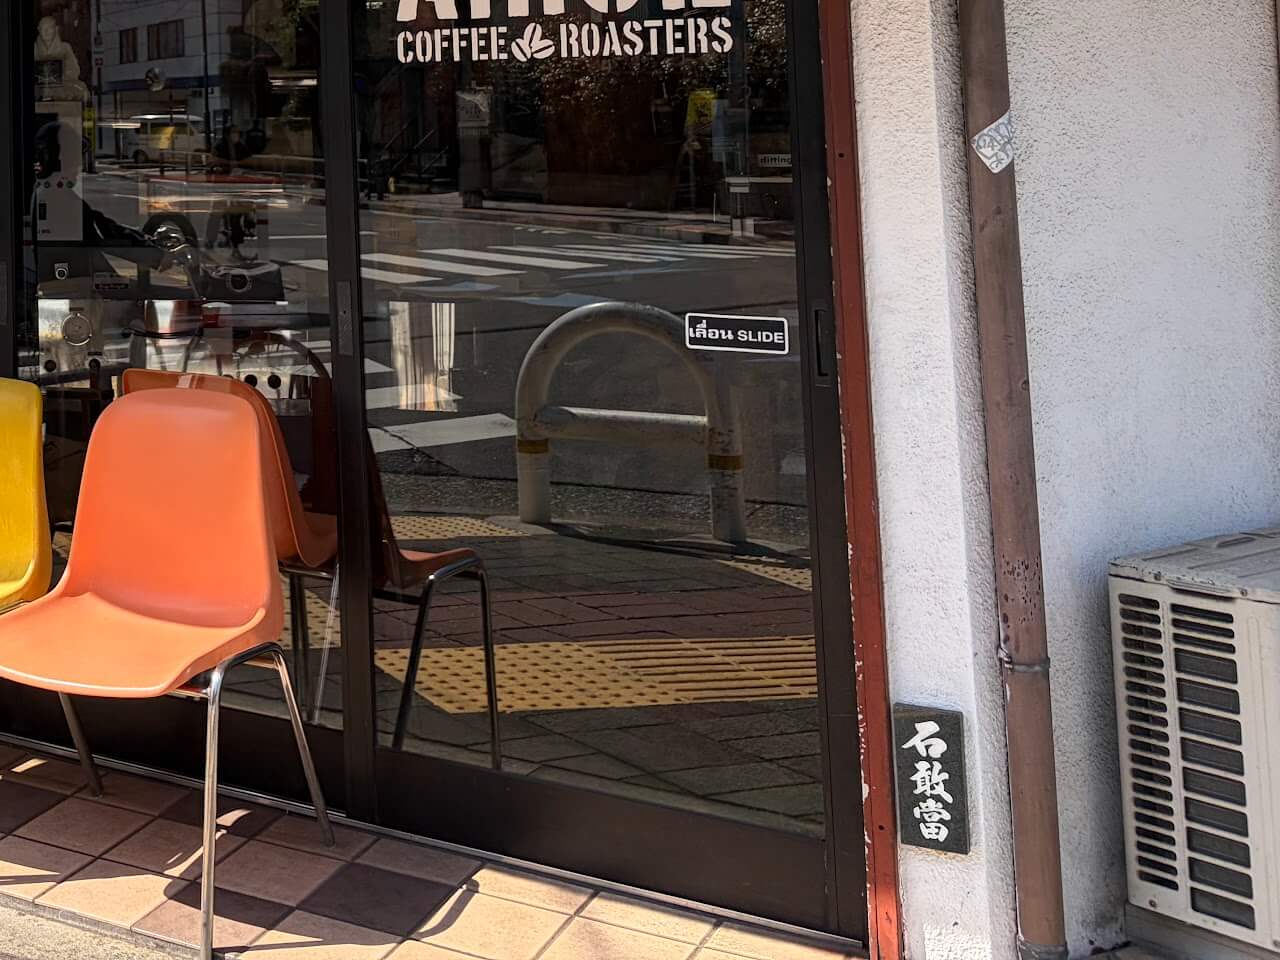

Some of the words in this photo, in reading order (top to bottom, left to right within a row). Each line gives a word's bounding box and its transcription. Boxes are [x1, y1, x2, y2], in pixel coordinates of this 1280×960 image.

[396, 26, 509, 64] COFFEE
[559, 16, 734, 58] ROASTERS
[689, 319, 734, 341] เลื่อน
[737, 329, 785, 344] SLIDE
[901, 720, 954, 843] 石敢當
